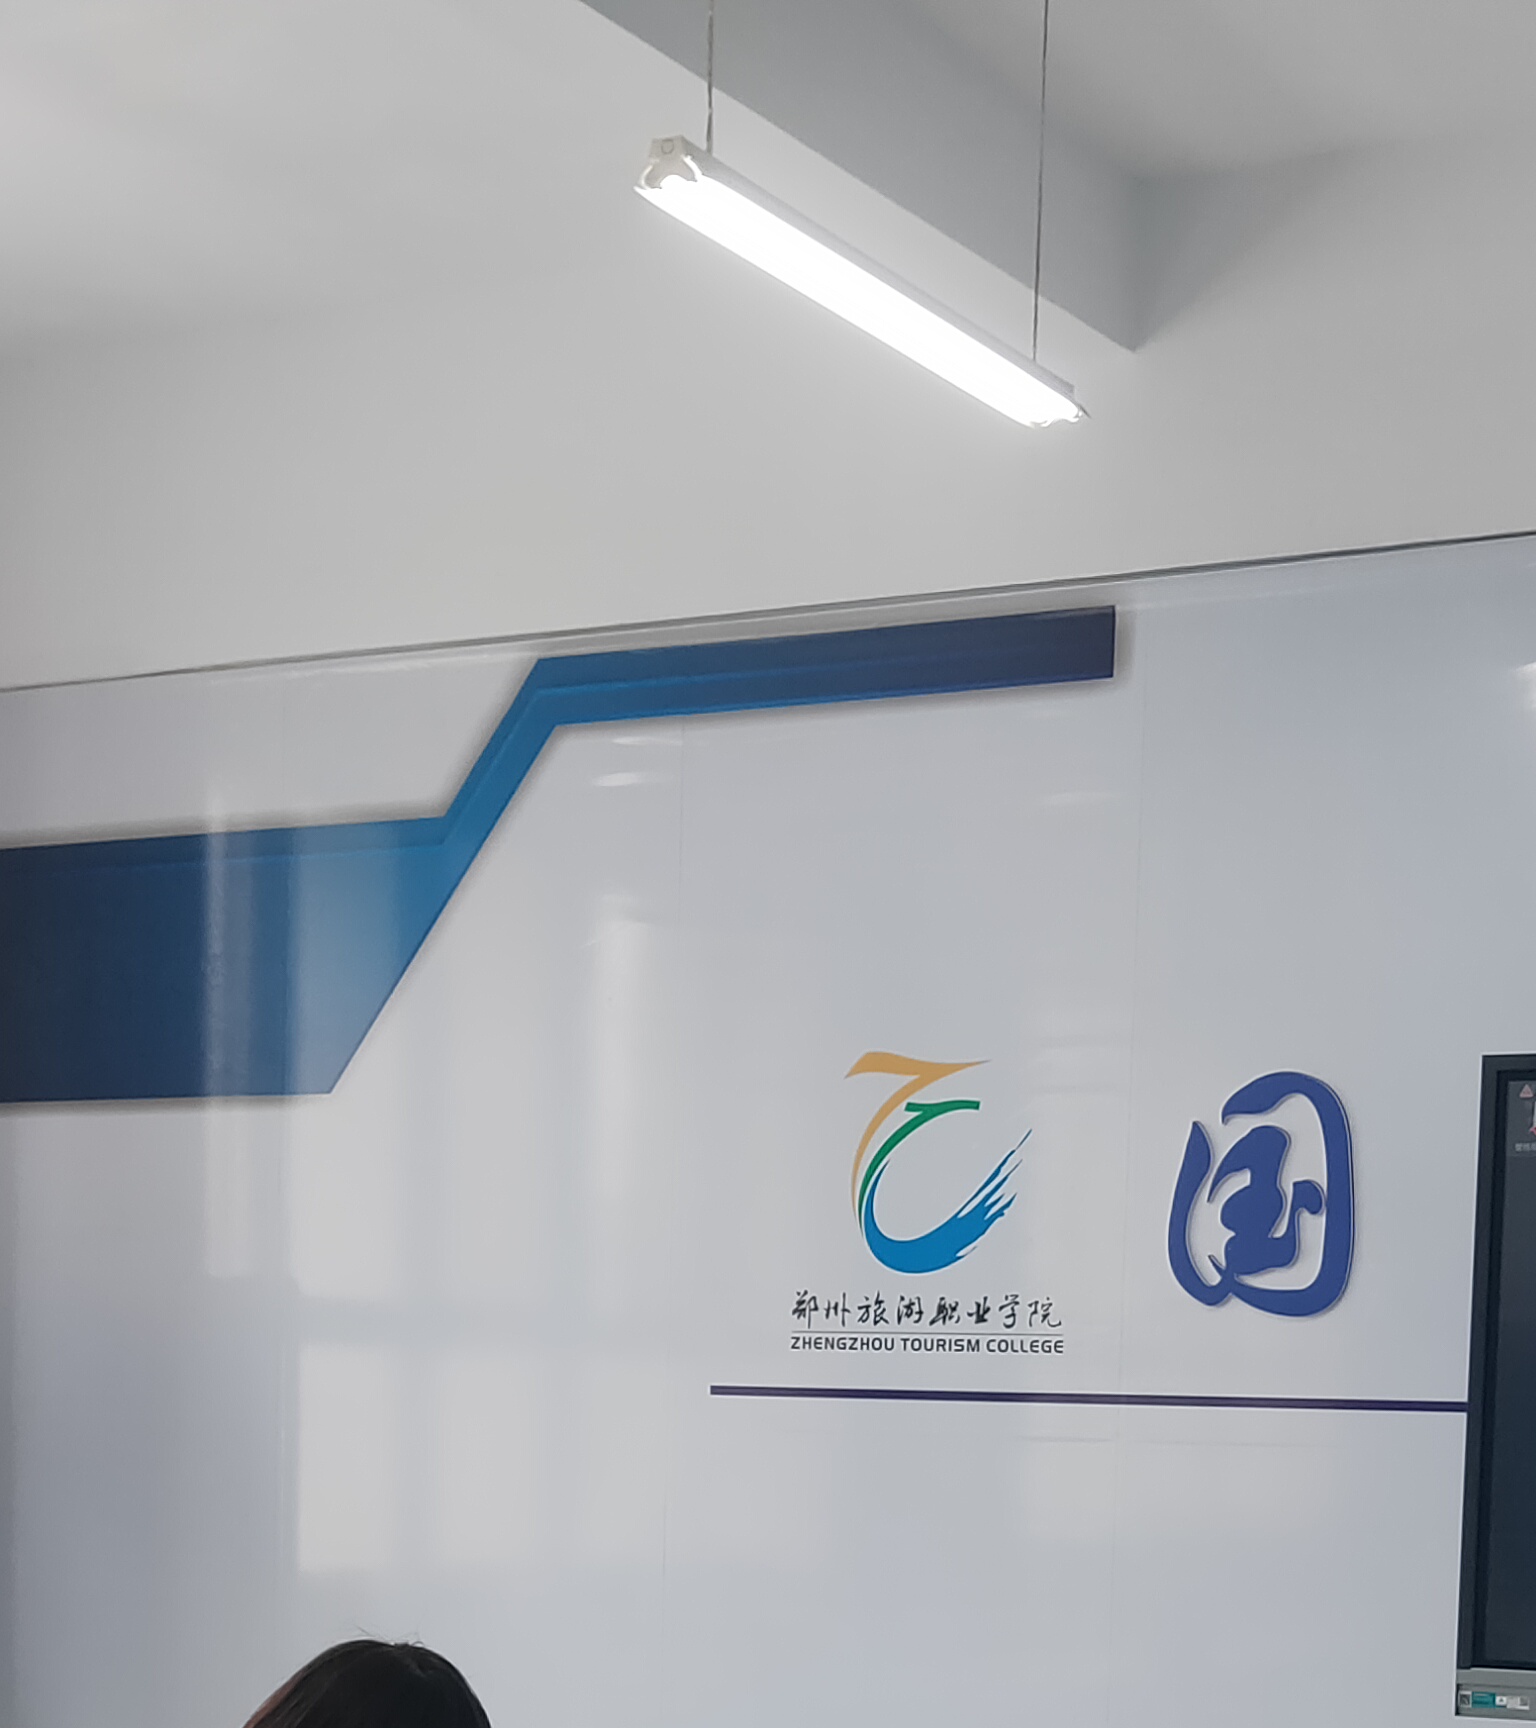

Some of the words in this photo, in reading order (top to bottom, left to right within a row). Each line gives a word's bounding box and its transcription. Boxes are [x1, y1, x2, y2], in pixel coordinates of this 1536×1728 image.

[791, 1289, 1063, 1329] 郑州旅游职业学院
[790, 1335, 895, 1352] ZHENGZHOU
[900, 1337, 981, 1353] TOURISM
[986, 1338, 1064, 1354] COLLEGE
